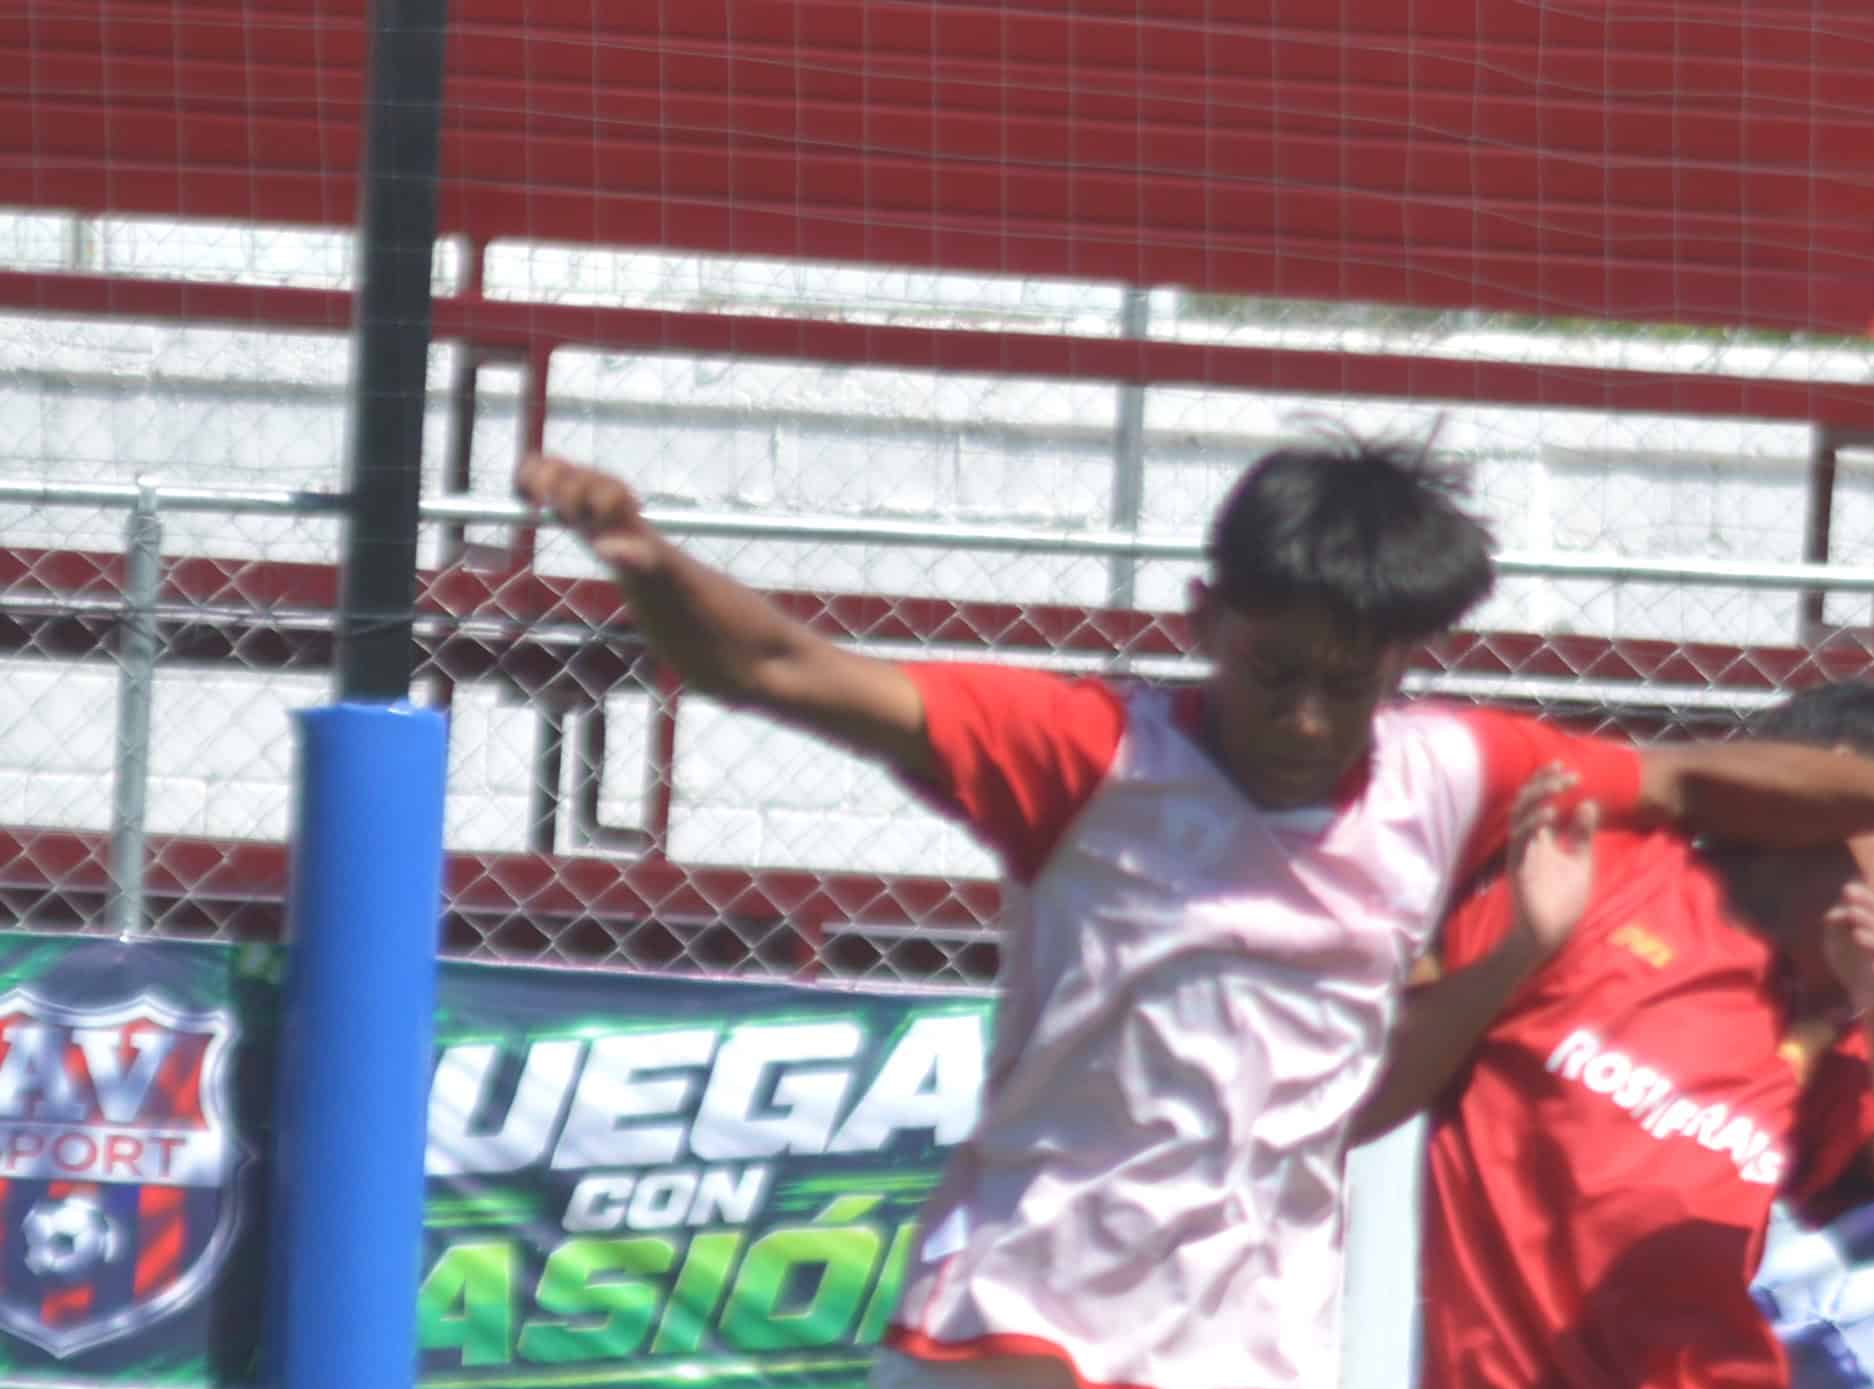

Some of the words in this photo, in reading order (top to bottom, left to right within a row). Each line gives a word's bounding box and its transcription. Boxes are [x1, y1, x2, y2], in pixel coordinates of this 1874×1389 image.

[0, 1024, 177, 1122] AV
[424, 1012, 988, 1176] UEGA
[0, 1132, 187, 1178] PORT
[562, 1167, 766, 1233] CON
[416, 1194, 922, 1367] ASIÓ
